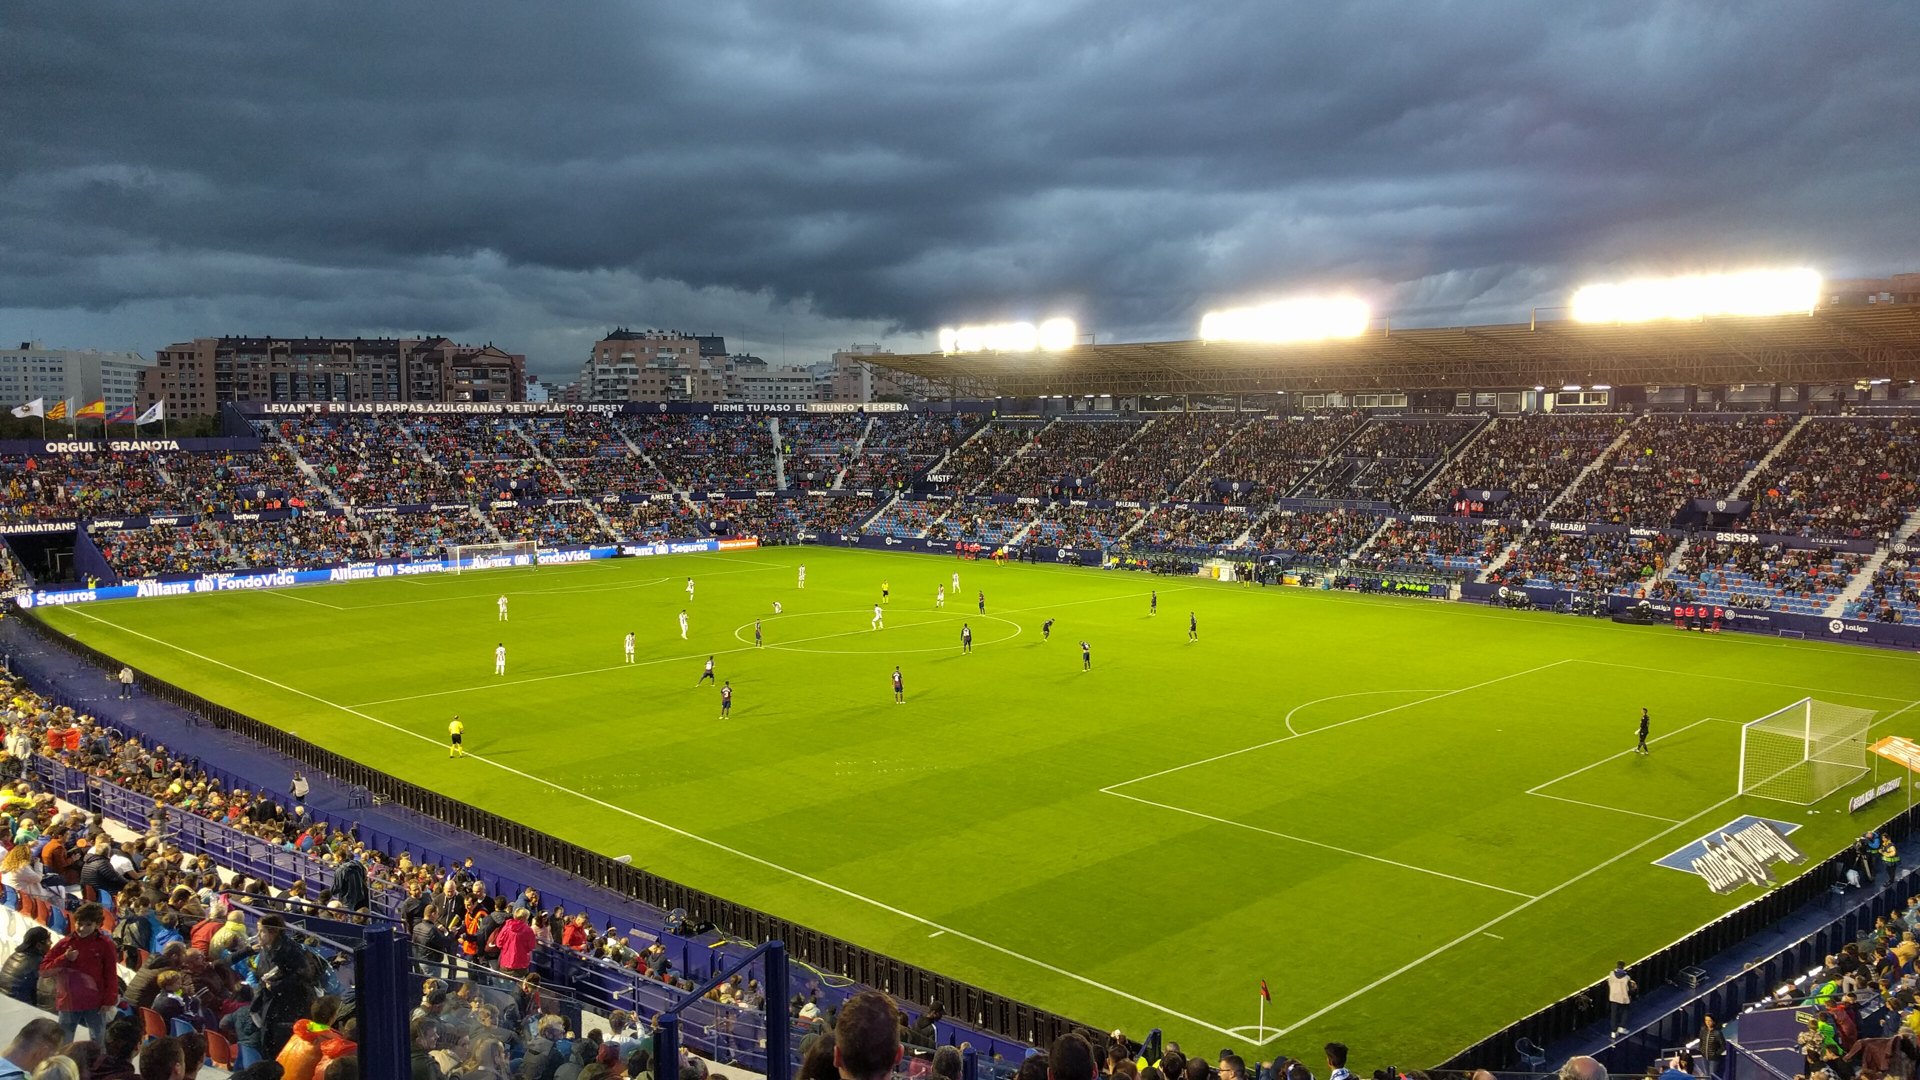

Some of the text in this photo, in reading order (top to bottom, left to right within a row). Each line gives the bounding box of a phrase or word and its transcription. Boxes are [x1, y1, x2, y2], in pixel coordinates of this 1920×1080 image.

[329, 403, 345, 412] EN
[350, 403, 373, 412] LAS
[428, 403, 502, 412] AZULGRANAS
[506, 403, 520, 412] DE
[523, 403, 538, 412] TU
[587, 403, 625, 412] JERSEY
[713, 403, 744, 412] FIRME
[748, 403, 761, 412] TU
[763, 403, 791, 412] PASO
[795, 403, 808, 412] EL
[811, 403, 854, 411] TRIUNFO
[873, 403, 909, 411] ESPERA
[111, 440, 180, 451] GRANOTA
[233, 512, 260, 521] betway
[1410, 514, 1437, 523] AMSTEL
[94, 520, 124, 529] betway
[150, 517, 178, 526] betway
[671, 543, 708, 553] Seguros
[330, 563, 443, 581] Allianz Seguros
[137, 573, 295, 598] Allianz FondoVida
[36, 590, 97, 606] Seguros
[1845, 624, 1868, 633] LaLiga
